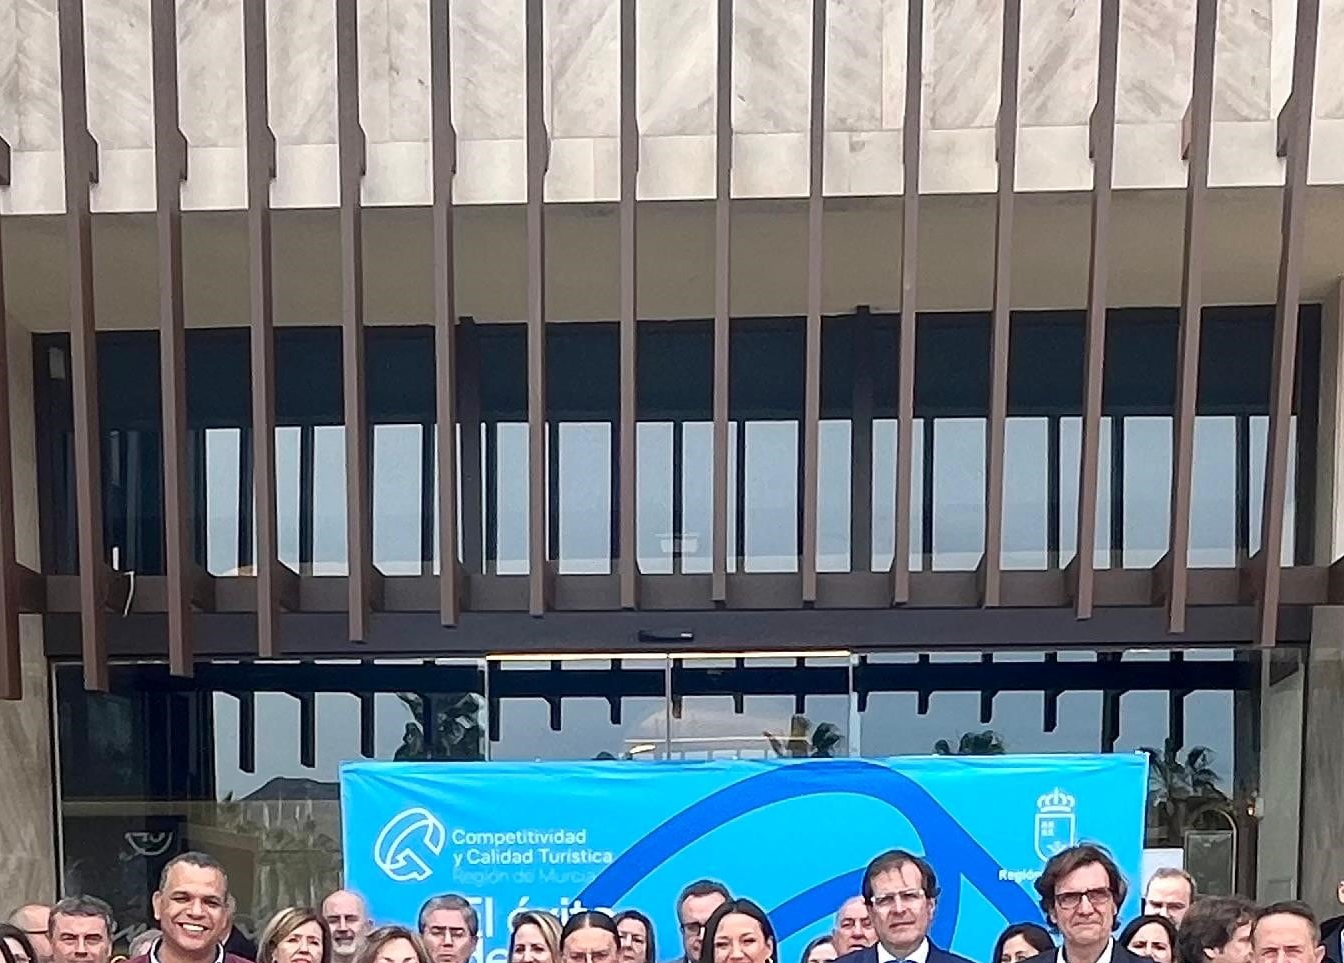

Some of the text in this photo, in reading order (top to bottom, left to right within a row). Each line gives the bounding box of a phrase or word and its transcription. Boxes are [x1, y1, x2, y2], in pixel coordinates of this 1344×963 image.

[452, 829, 587, 847] Competitividad
[453, 848, 614, 867] y Calidad Turística
[452, 867, 599, 885] Región de Murcia
